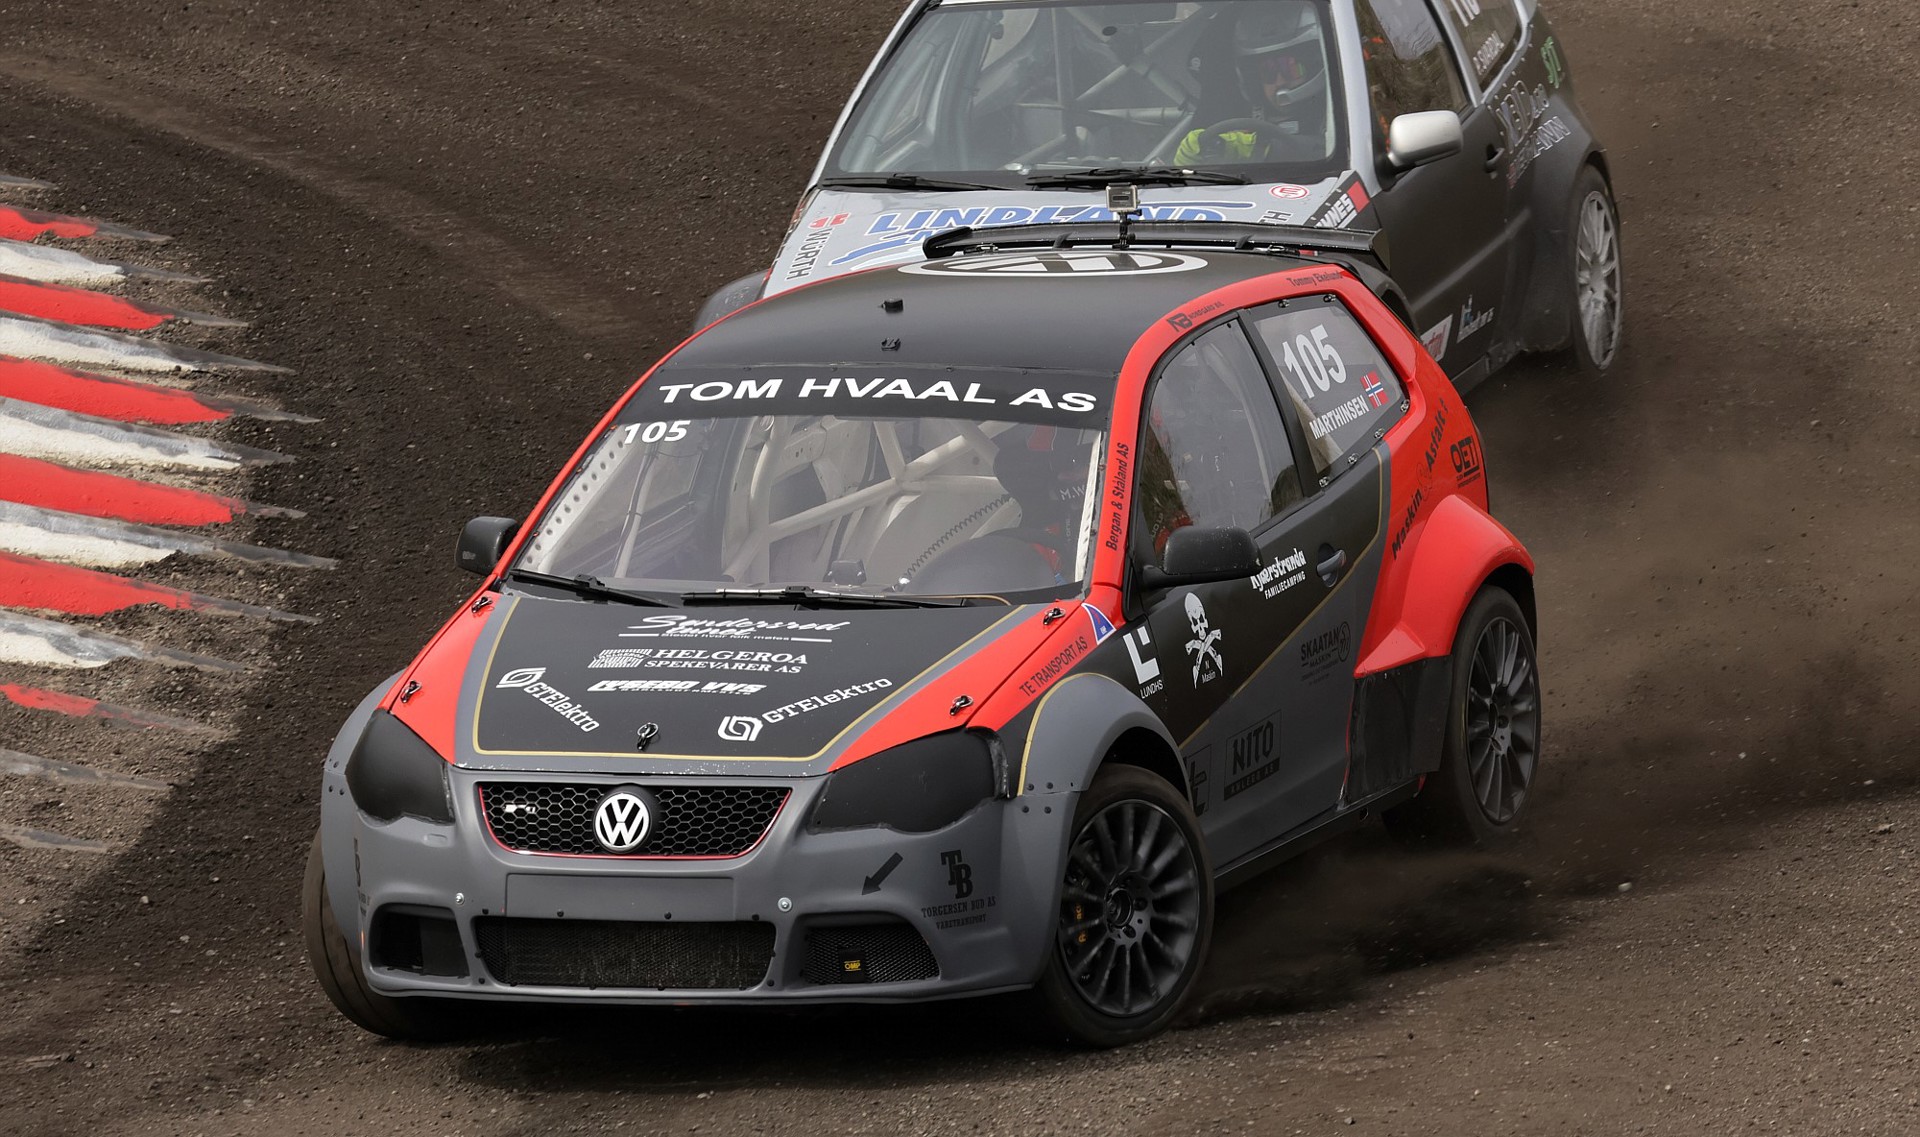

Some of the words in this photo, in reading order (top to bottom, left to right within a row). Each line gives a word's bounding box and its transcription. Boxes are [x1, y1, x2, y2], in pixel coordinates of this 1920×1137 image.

[786, 228, 832, 281] WÜRTH
[1282, 324, 1347, 398] 105
[658, 378, 783, 403] TOM
[797, 377, 996, 404] HVAAL
[1009, 388, 1098, 412] AS
[624, 420, 691, 444] 105
[1309, 395, 1370, 439] MARTHINSEN
[1117, 442, 1129, 459] AS
[1392, 488, 1423, 560] Maskin
[1424, 409, 1446, 472] Asfalt
[1111, 501, 1122, 510] &
[1106, 512, 1123, 551] Bergan
[1264, 570, 1306, 600] FAMILIECAMPING
[644, 660, 771, 671] SPEKEVARER
[774, 665, 801, 674] AS
[655, 649, 808, 664] HELGEROA
[1019, 682, 1036, 697] TE
[1031, 644, 1078, 688] TRANSPORT
[1076, 635, 1088, 653] AS
[523, 681, 600, 732] GTElektro
[761, 678, 893, 724] GTElektro
[1140, 679, 1164, 699] LUNDHS
[1232, 721, 1274, 775] NITO
[921, 901, 968, 918] TORGERSEN
